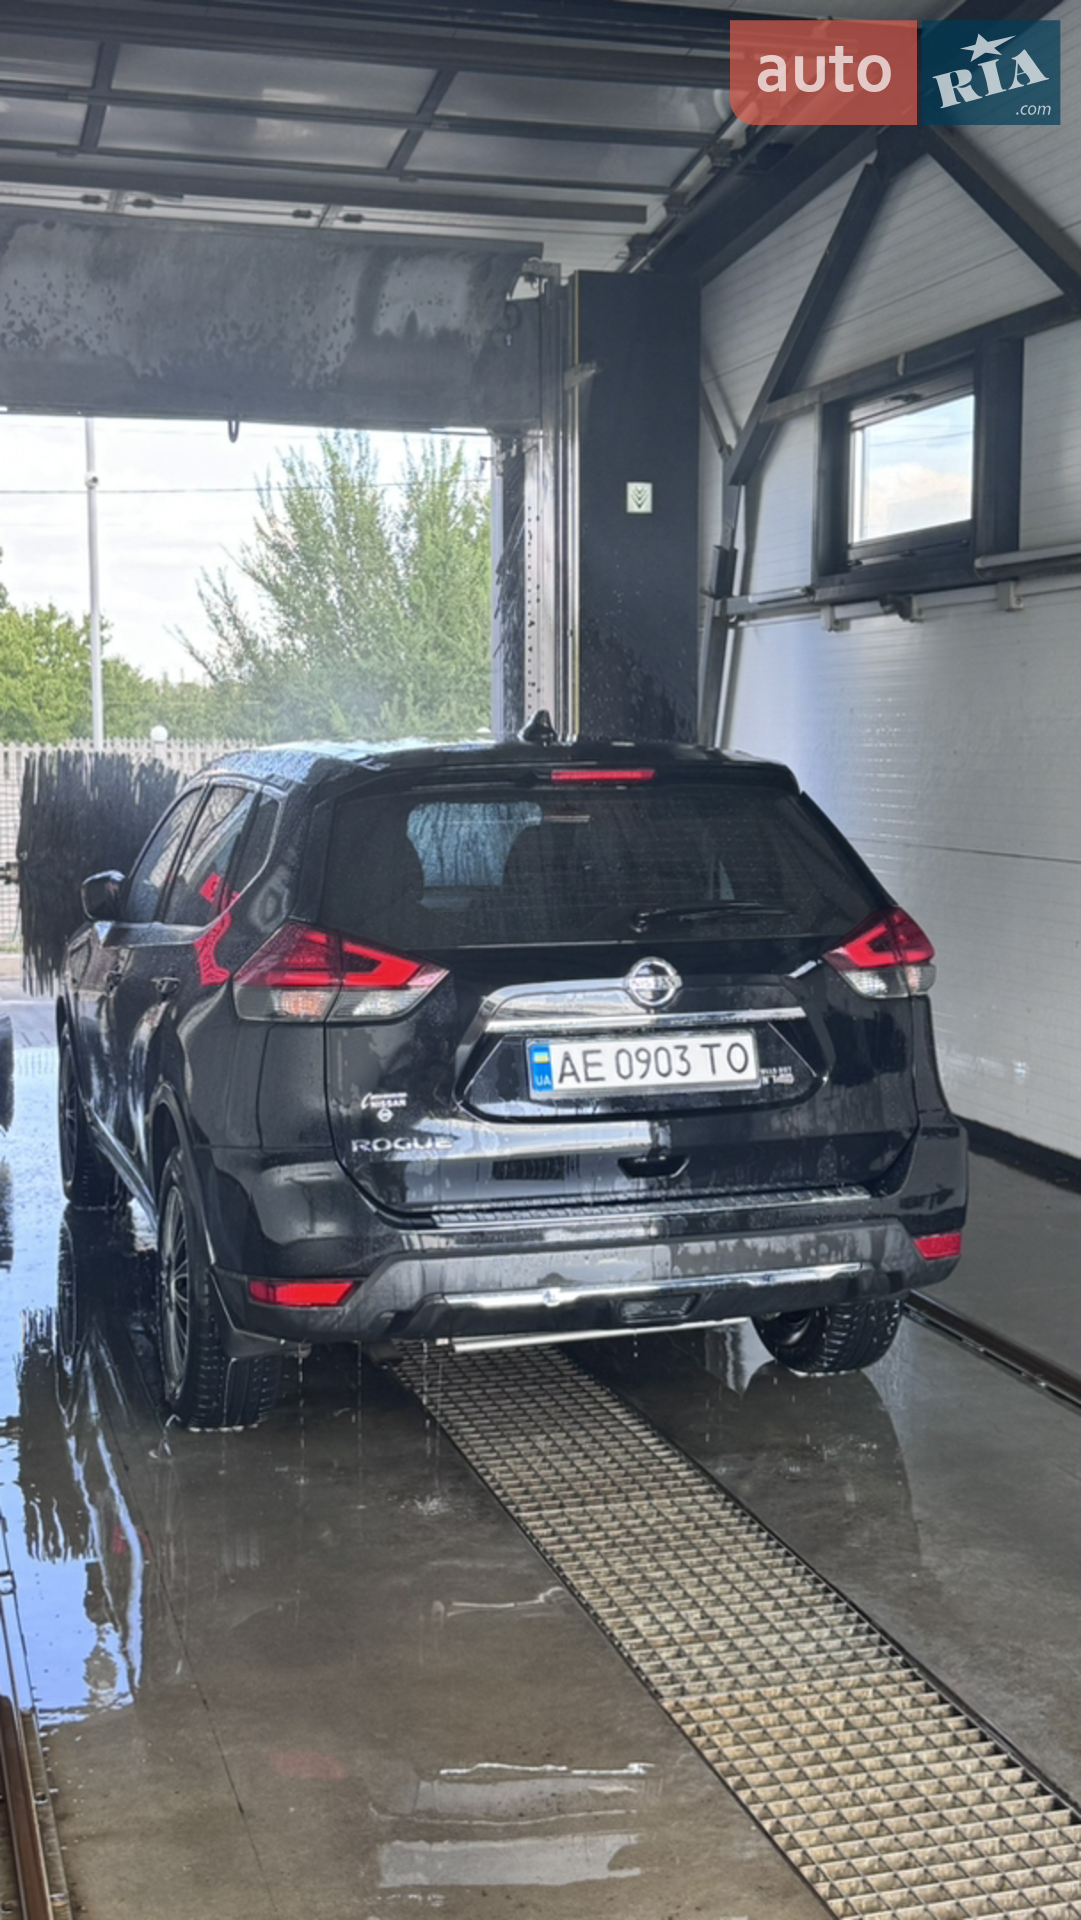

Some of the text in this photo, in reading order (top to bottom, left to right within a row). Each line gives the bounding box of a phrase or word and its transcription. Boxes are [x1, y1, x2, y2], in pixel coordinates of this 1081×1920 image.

[558, 1042, 749, 1084] AE 0903 TO
[535, 1075, 552, 1087] UA
[351, 1137, 453, 1153] ROGUE
